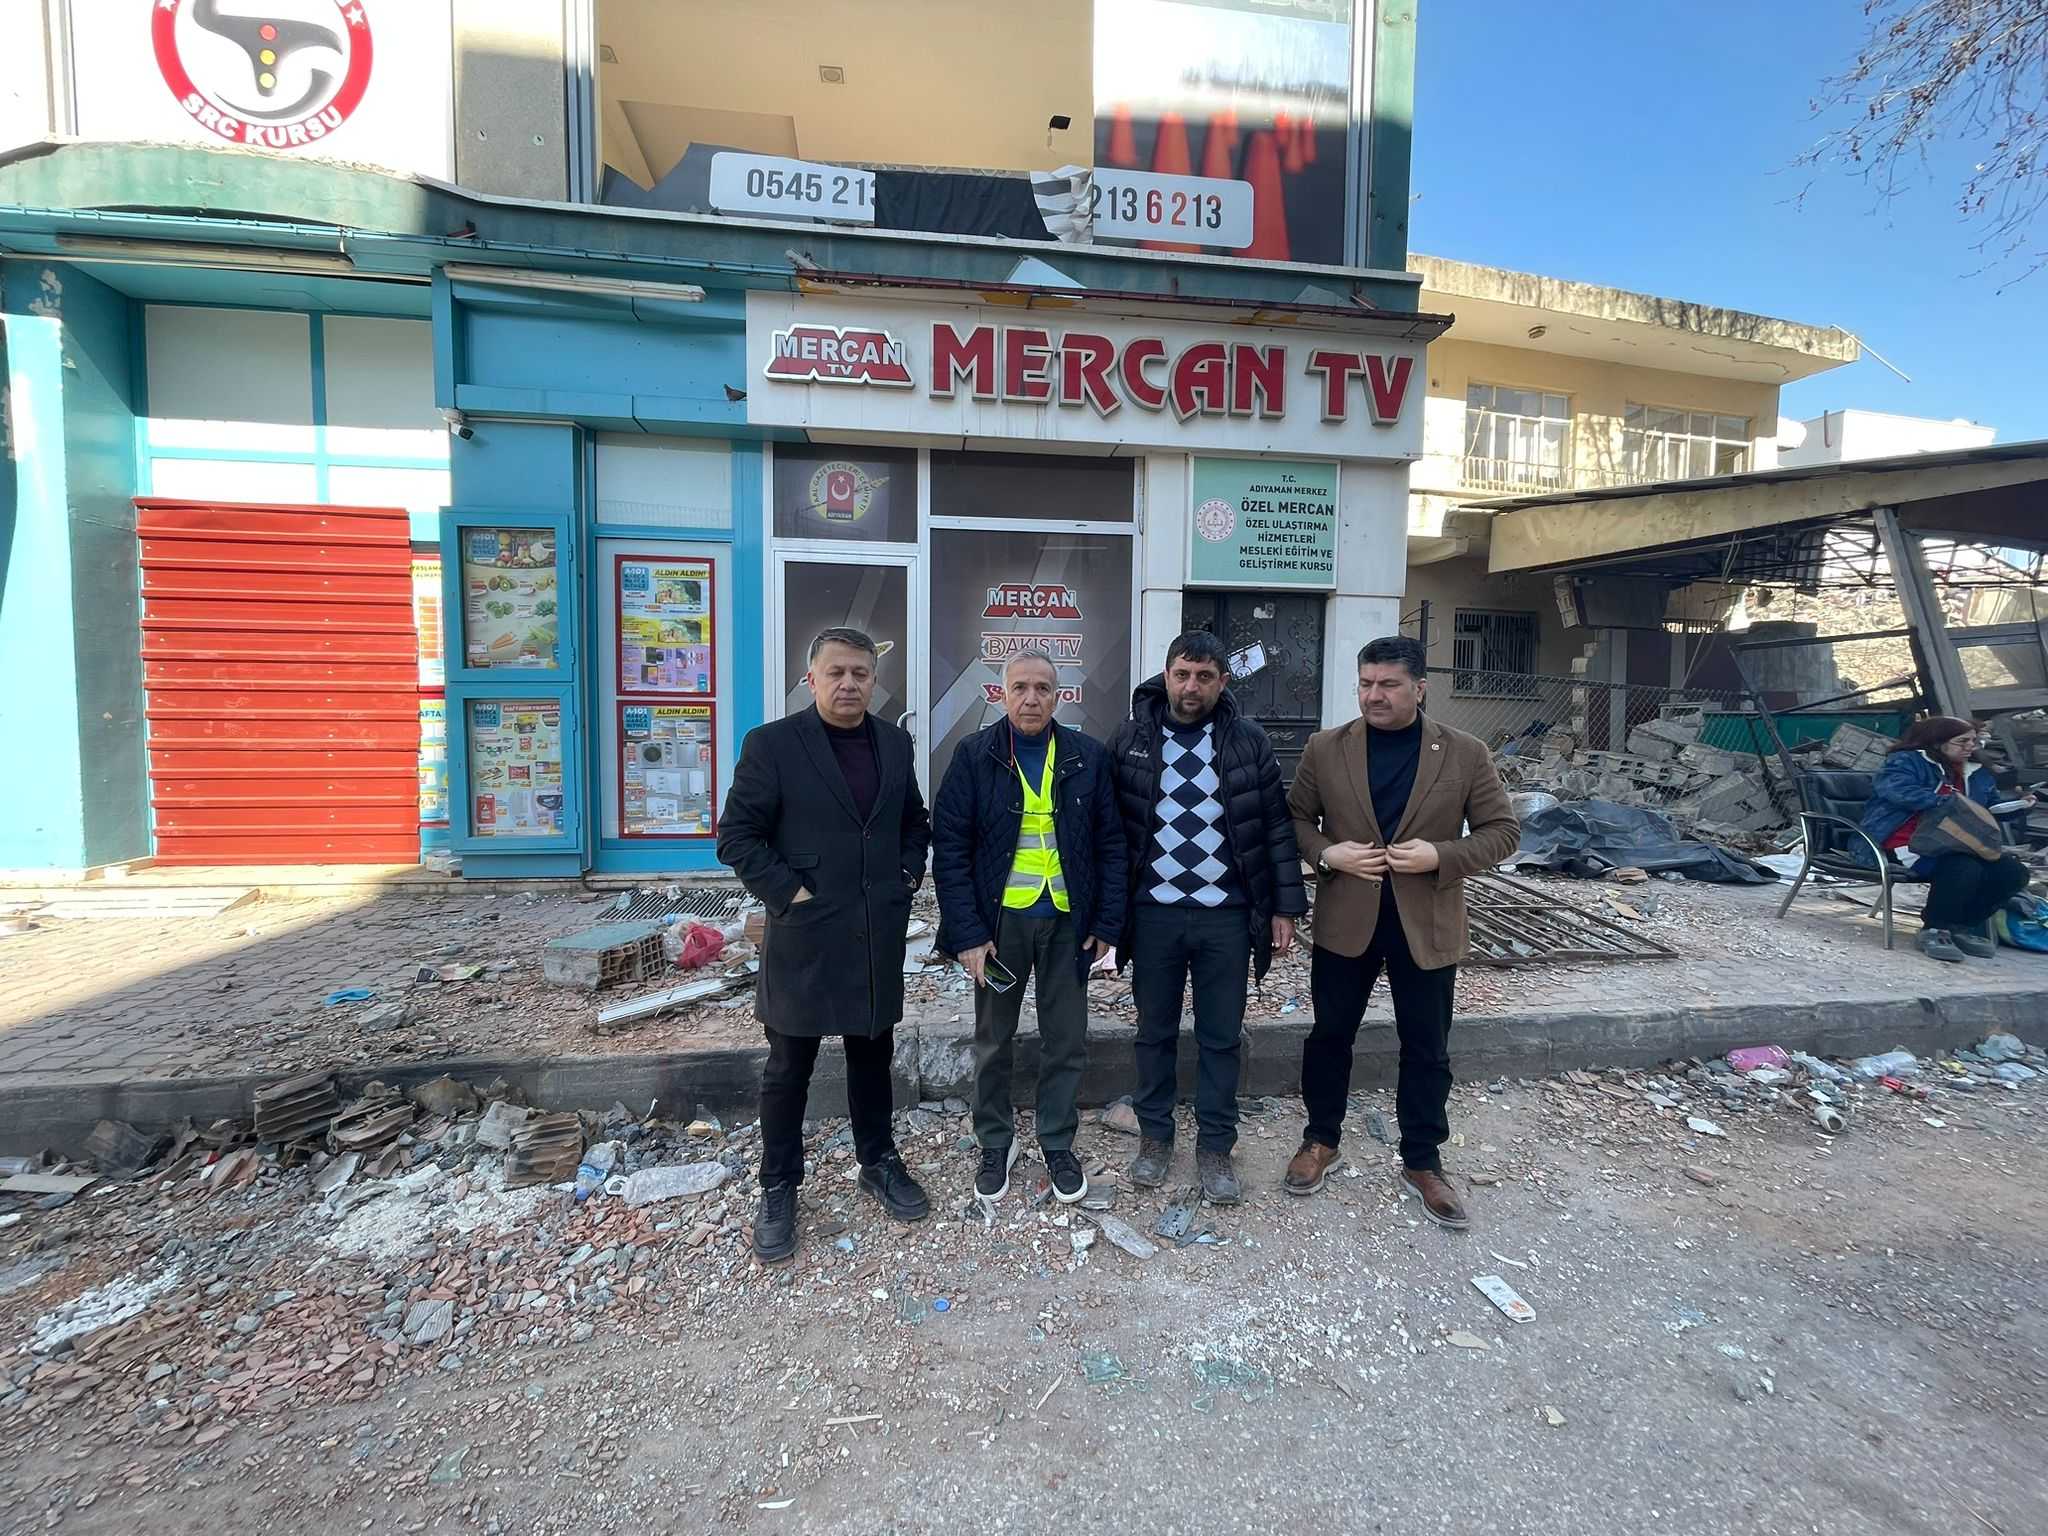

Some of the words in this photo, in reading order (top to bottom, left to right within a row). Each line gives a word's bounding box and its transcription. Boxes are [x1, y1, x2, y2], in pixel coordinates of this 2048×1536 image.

[183, 93, 239, 138] SRC
[243, 105, 343, 146] KURSU
[747, 168, 823, 202] 0545
[775, 334, 902, 366] MERCAN
[826, 363, 854, 376] TV
[930, 320, 1287, 423] MERCAN
[1305, 348, 1415, 426] TV
[1281, 474, 1297, 483] T.C.
[1249, 485, 1292, 494] ADIYAMAN
[1294, 487, 1327, 496] MERKEZ
[1241, 496, 1275, 513] ÖZEL
[1278, 502, 1334, 516] MERCAN
[1245, 517, 1270, 529] ÖZEL
[1272, 520, 1328, 532] ULAŞTIRMA
[1258, 531, 1316, 544] HİZMETLERİ
[1240, 543, 1283, 556] MESLEKİ
[1285, 545, 1318, 558] EĞİTİM
[1321, 549, 1333, 559] VE
[1239, 557, 1298, 570] GELİŞTİRME
[1300, 561, 1333, 572] KURSU
[989, 590, 1075, 607] MERCAN
[1024, 608, 1041, 616] TV
[1056, 639, 1081, 656] TV
